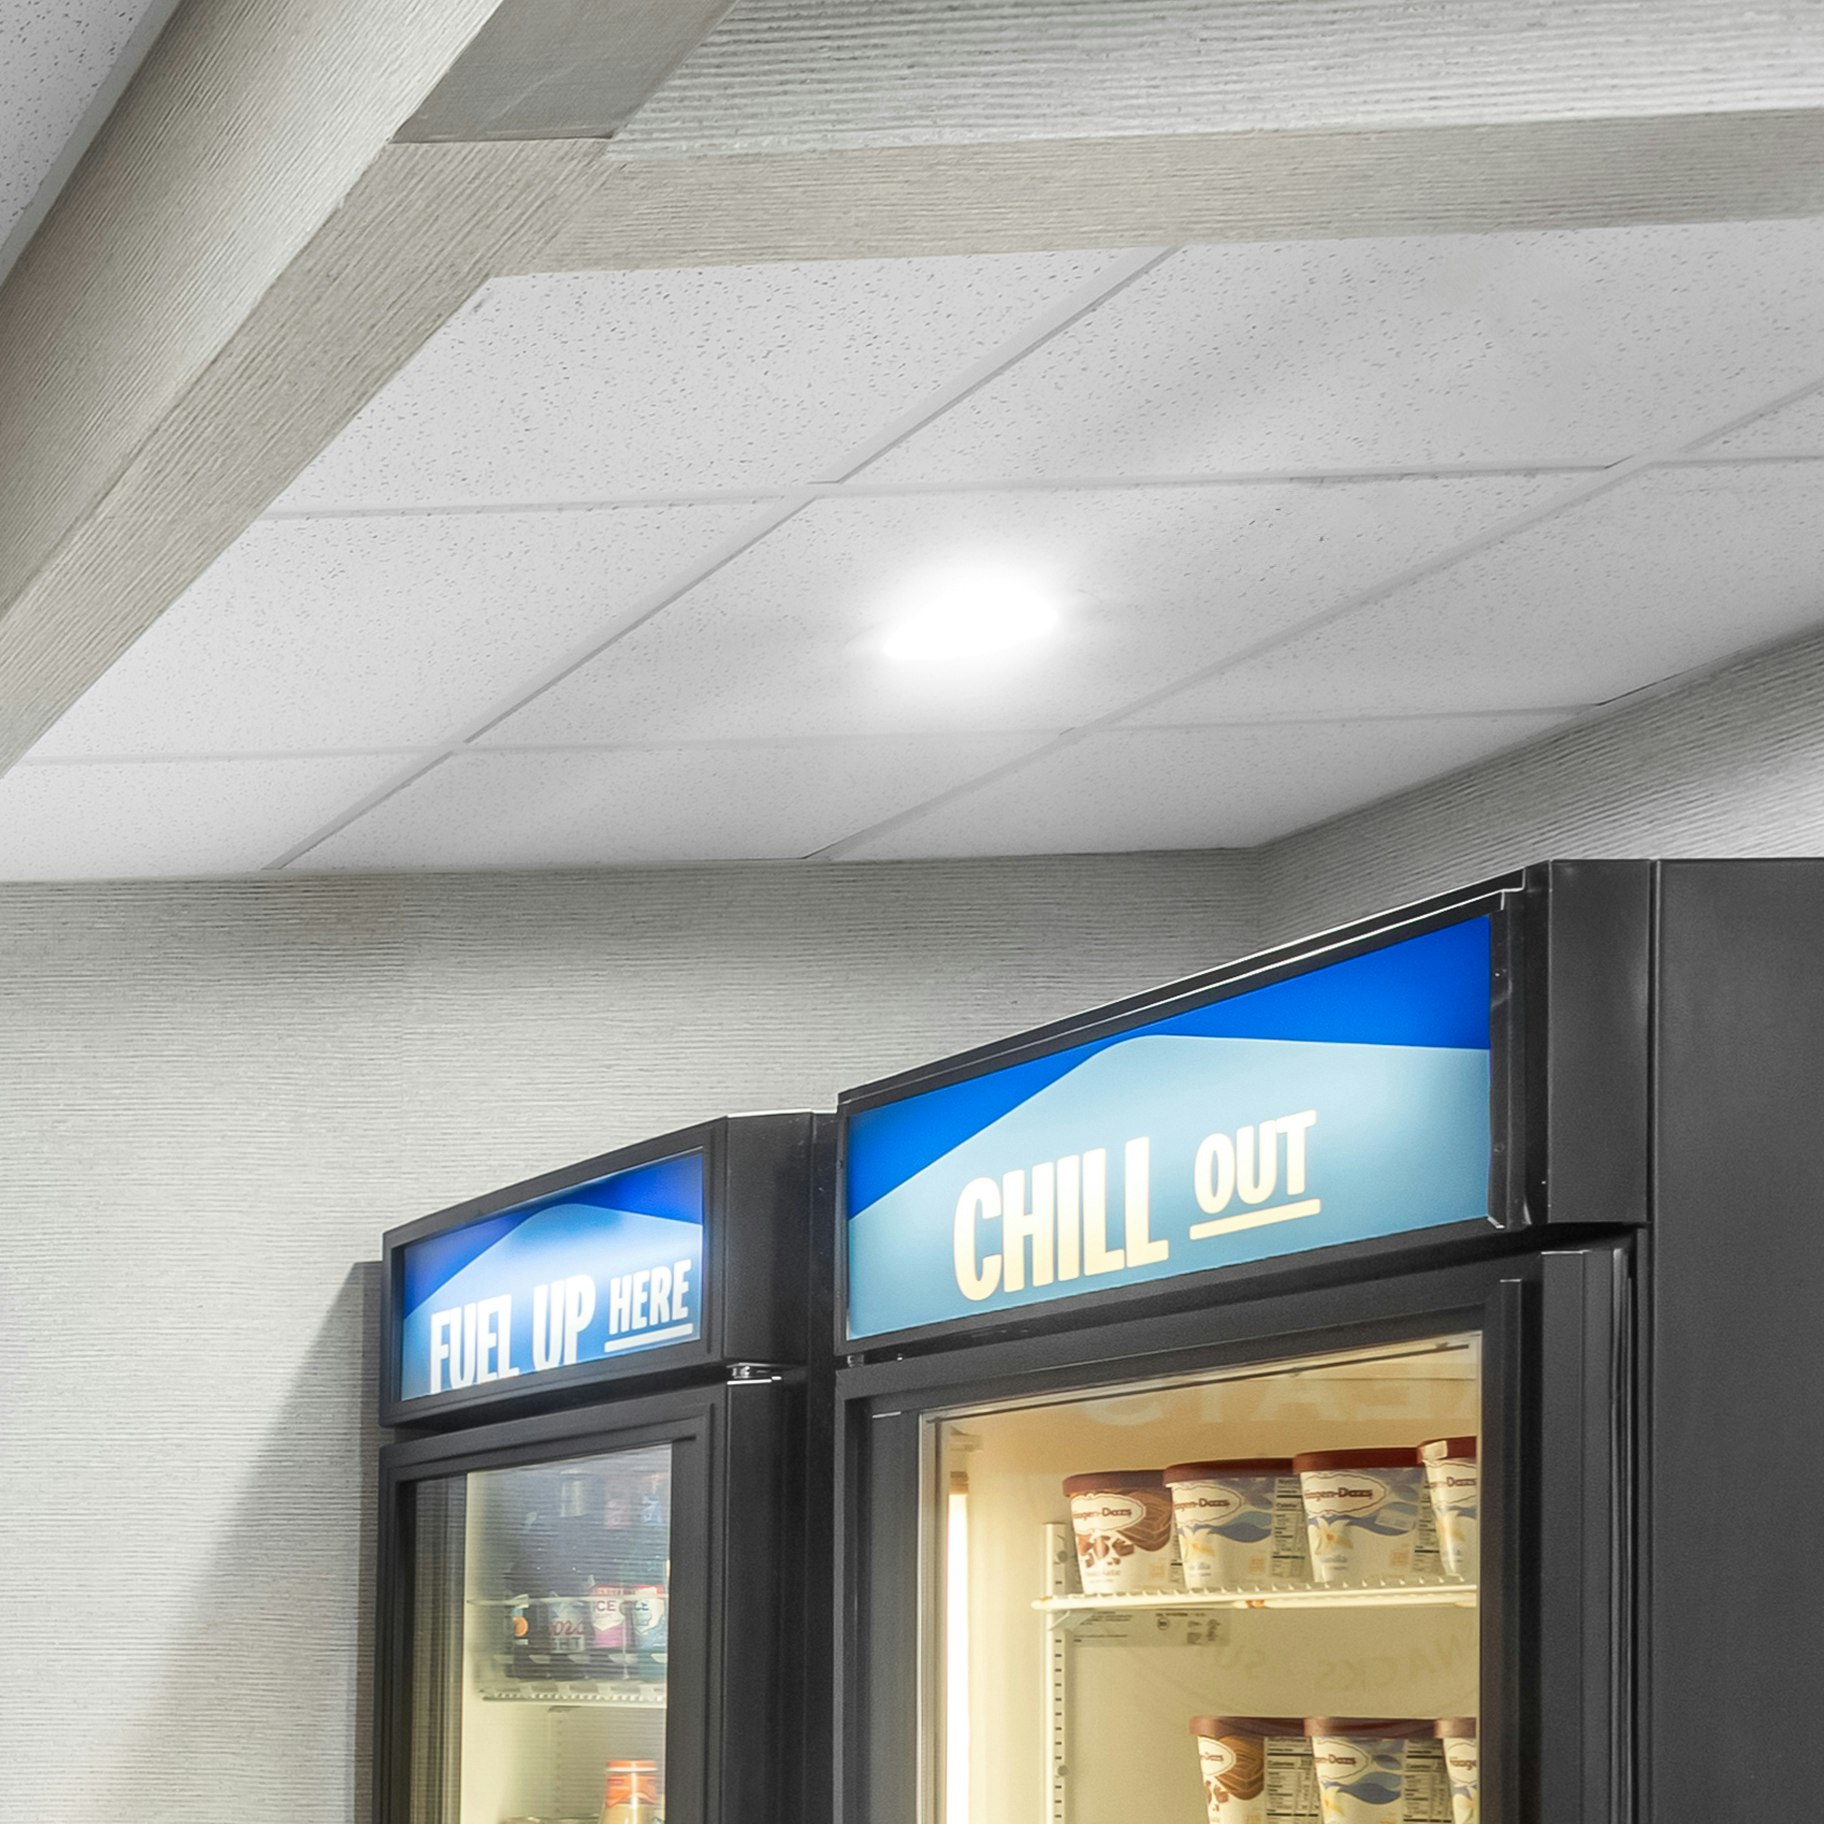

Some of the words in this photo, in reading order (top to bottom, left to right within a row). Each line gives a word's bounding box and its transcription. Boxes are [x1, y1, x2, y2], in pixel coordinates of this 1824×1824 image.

[952, 1136, 1169, 1301] CHILL
[1194, 1109, 1318, 1214] OUT
[430, 1294, 520, 1394] FUEL
[532, 1274, 596, 1371] UP
[609, 1259, 692, 1336] HERE
